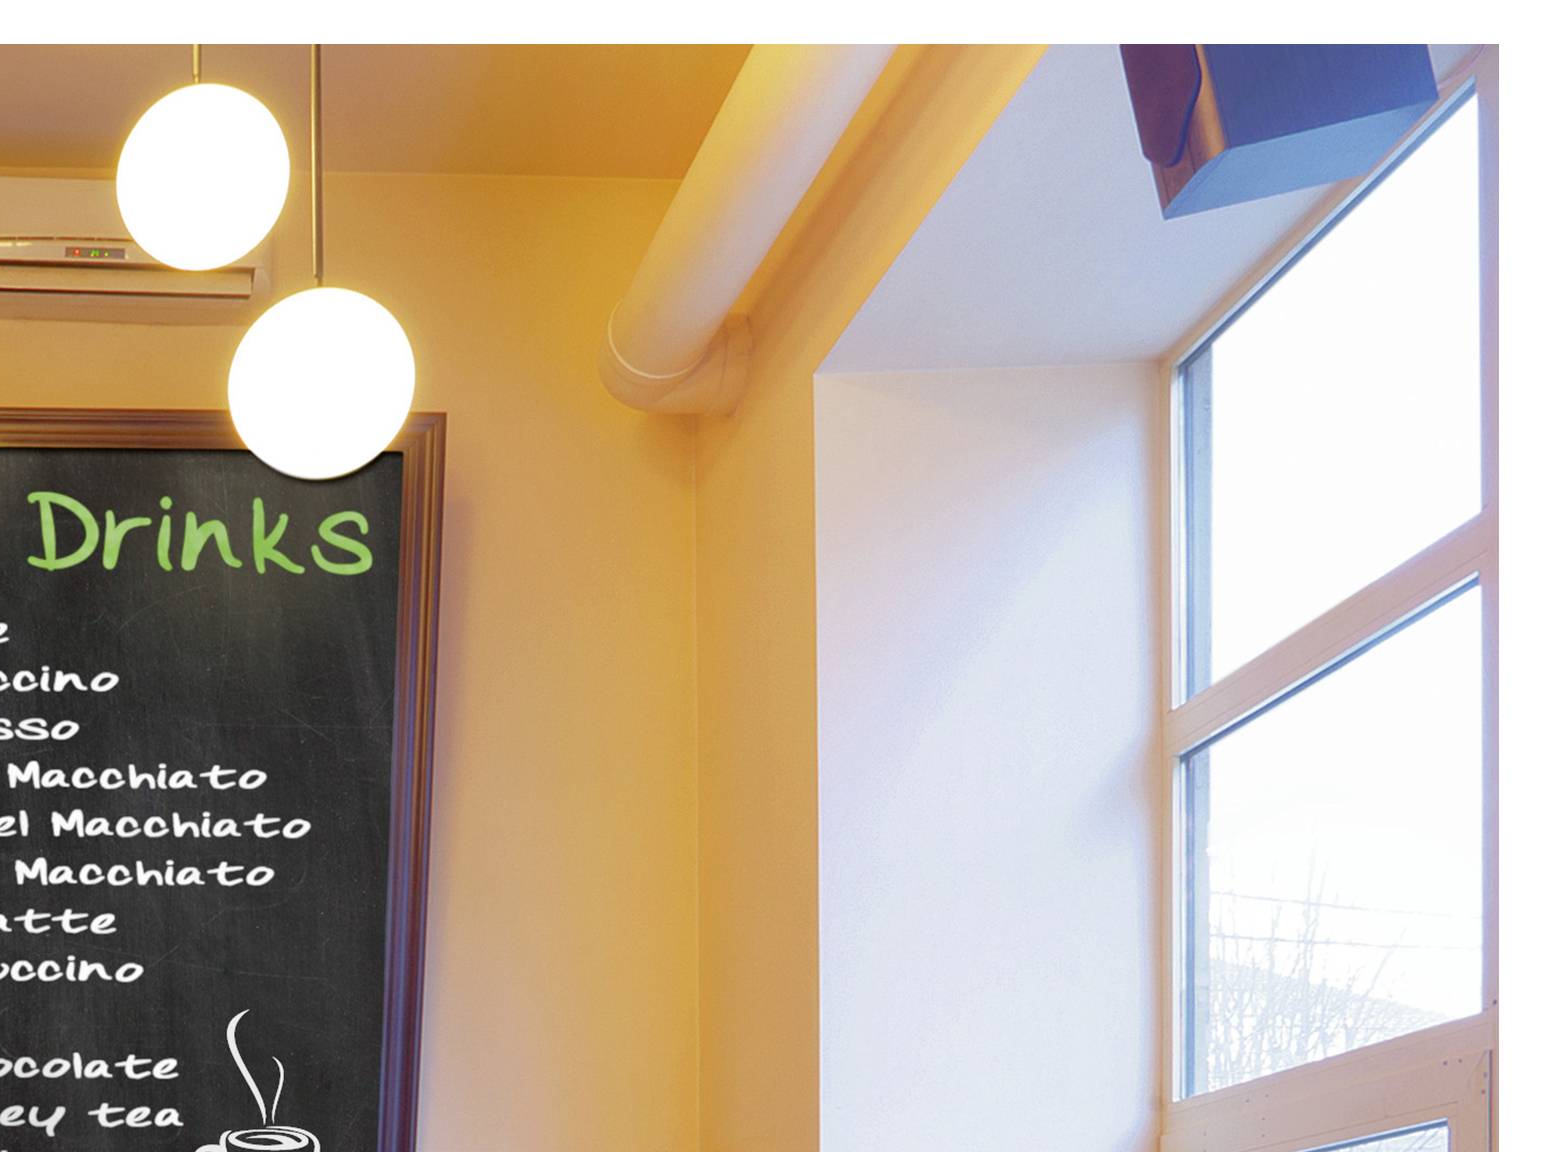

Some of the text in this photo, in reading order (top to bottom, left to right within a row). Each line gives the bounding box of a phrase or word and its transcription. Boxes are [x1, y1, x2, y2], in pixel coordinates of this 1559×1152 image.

[27, 491, 373, 576] Drinks
[6, 760, 268, 790] Macchiato
[50, 808, 312, 839] Macchiato
[14, 856, 275, 887] Macchiato
[87, 1102, 184, 1128] tea
